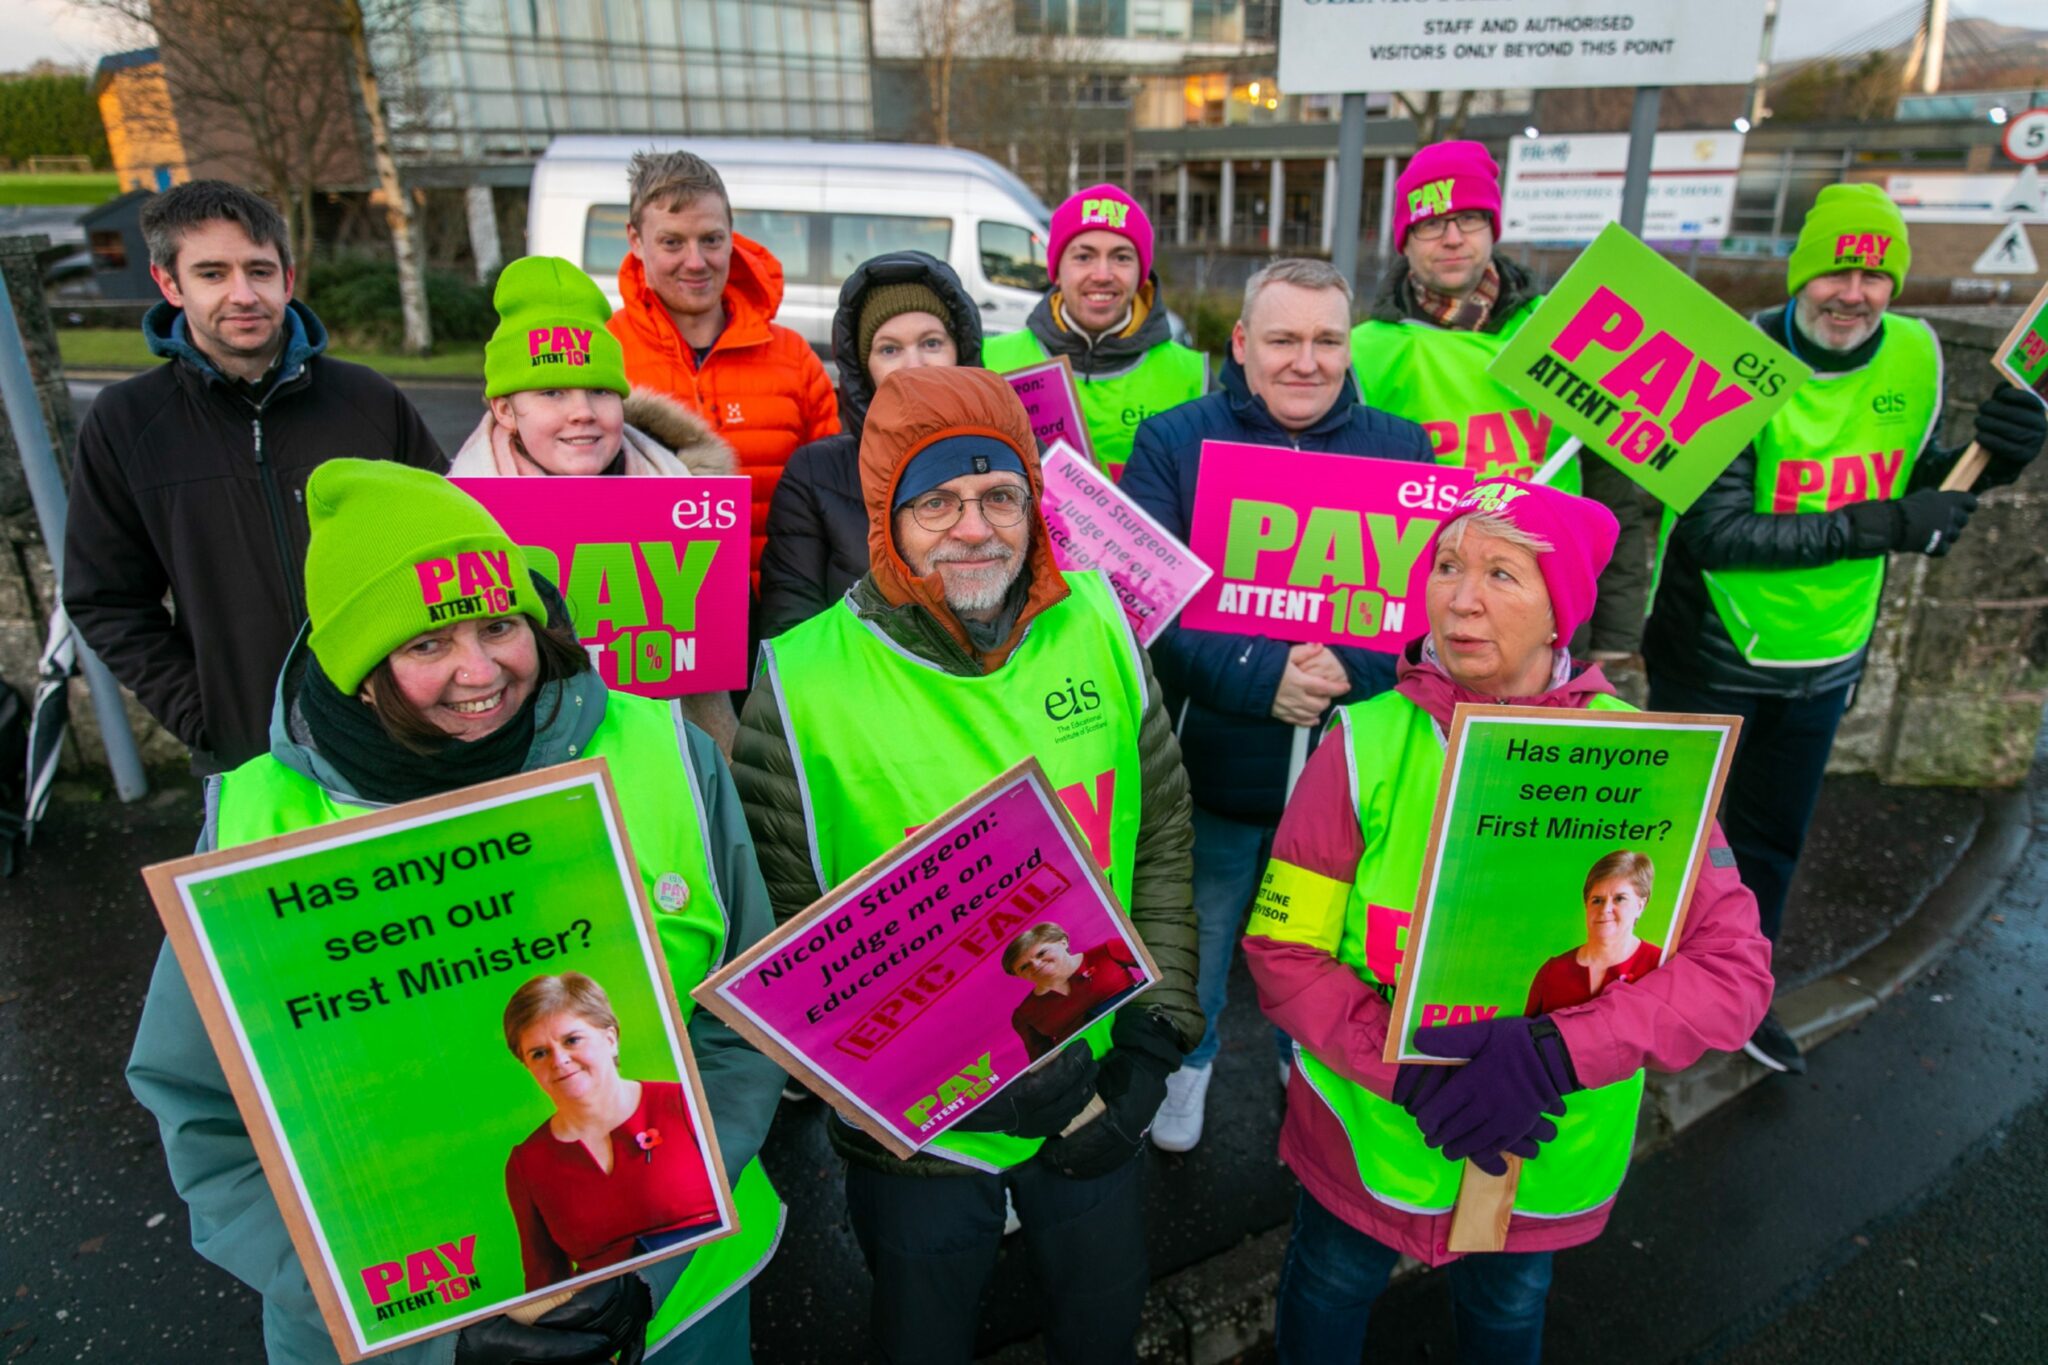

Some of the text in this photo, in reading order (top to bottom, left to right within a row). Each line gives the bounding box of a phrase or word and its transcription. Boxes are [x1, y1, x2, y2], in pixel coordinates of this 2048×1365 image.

[1370, 39, 1675, 60] VISITORS ONLY BEYOND THIS POINT
[1424, 15, 1634, 35] STAFF AND AUTHORISED
[1082, 199, 1130, 219] PAY
[1408, 178, 1455, 213] PAY
[1835, 233, 1892, 257] PAY
[528, 326, 593, 357] PAY
[1550, 285, 1754, 445] PAY
[1733, 352, 1786, 398] eis
[1872, 389, 1906, 414] eis
[1424, 408, 1554, 474] PAY
[1397, 475, 1460, 512] eis
[1773, 449, 1905, 514] PAY
[672, 491, 737, 530] eis
[1059, 462, 1183, 572] Nicola Sturgeon:
[1054, 499, 1153, 582] Judge me on
[1222, 498, 1441, 598] PAY
[415, 550, 514, 605] PAY
[1045, 677, 1101, 721] eis
[1507, 739, 1669, 771] Has anyone
[1519, 784, 1643, 805] seen our
[1476, 814, 1672, 843] First Minister?
[267, 828, 533, 919] Has anyone
[758, 914, 854, 988] Nicola
[858, 812, 1000, 918] Sturgeon:
[1266, 889, 1291, 907] LINE
[325, 888, 519, 962] seen our
[805, 847, 1044, 1026] Education Record
[820, 852, 994, 988] Judge me on
[285, 918, 593, 1030] First Minister?
[848, 878, 1062, 1054] EPIC FAIL
[903, 1051, 994, 1127] PAY
[360, 1234, 477, 1306] PAY
